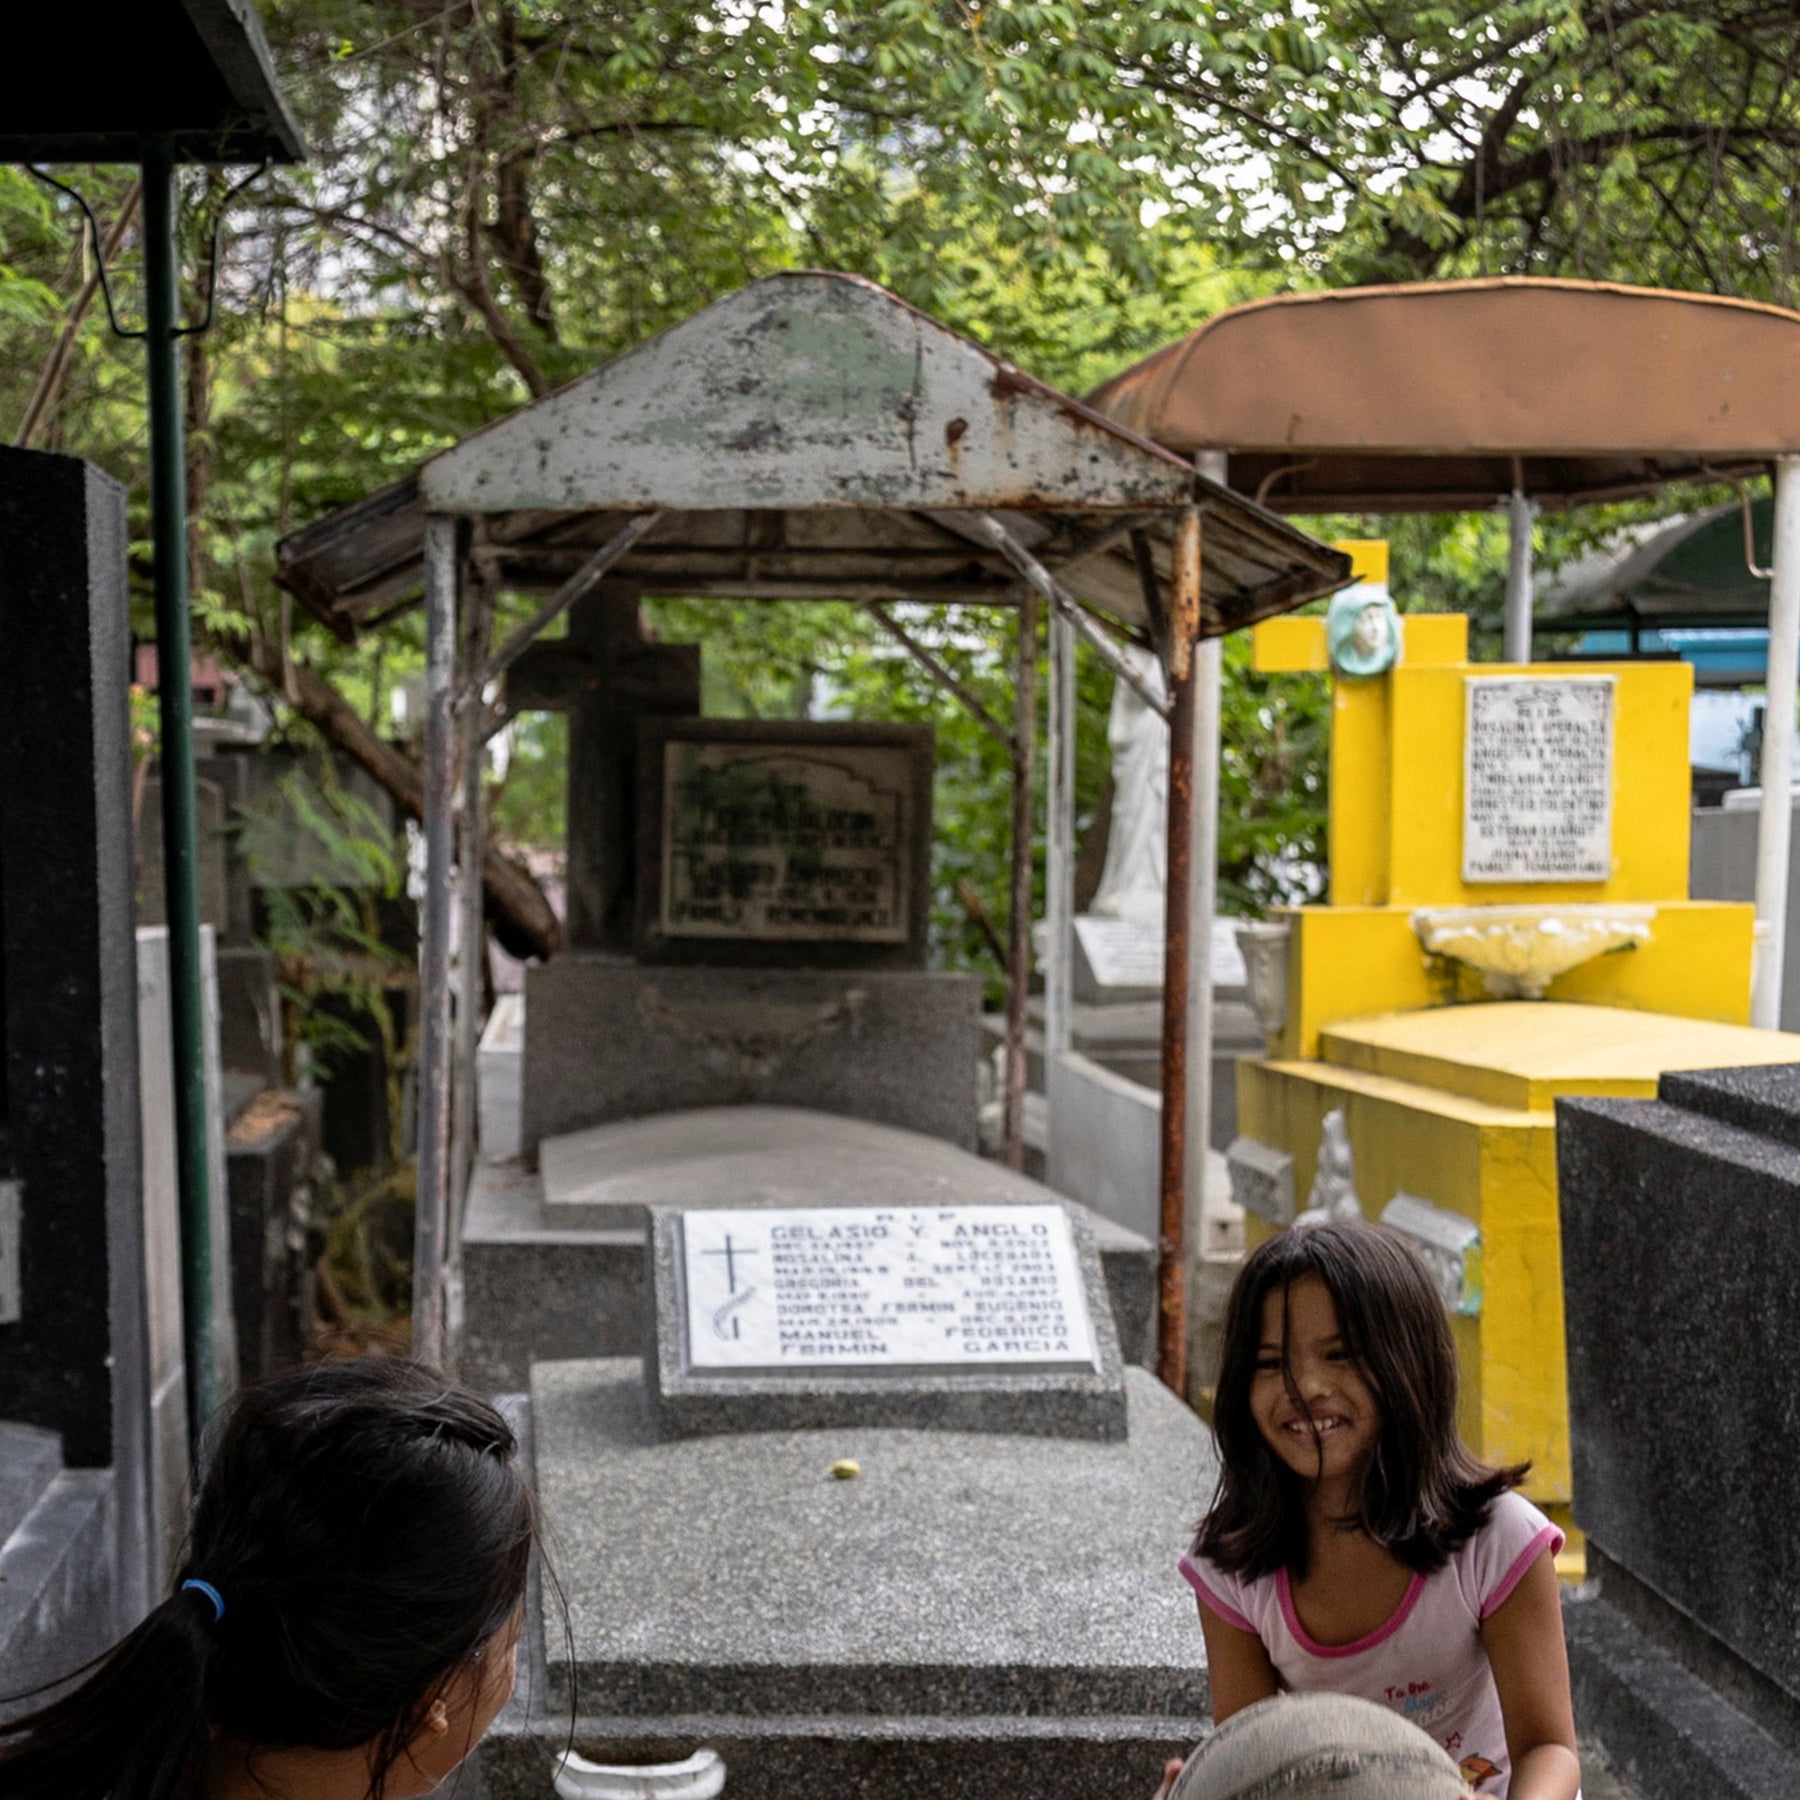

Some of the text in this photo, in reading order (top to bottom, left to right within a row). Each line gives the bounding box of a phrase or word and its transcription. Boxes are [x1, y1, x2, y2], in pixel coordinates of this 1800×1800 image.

[770, 1224, 889, 1241] GELASIO
[954, 1222, 1049, 1238] ANGLO
[881, 1302, 956, 1314] FERMIN
[974, 1300, 1063, 1312] EUGENIO
[779, 1326, 1069, 1341] MANUEL FEDERICO
[780, 1341, 1070, 1355] FERMIN GARCIA
